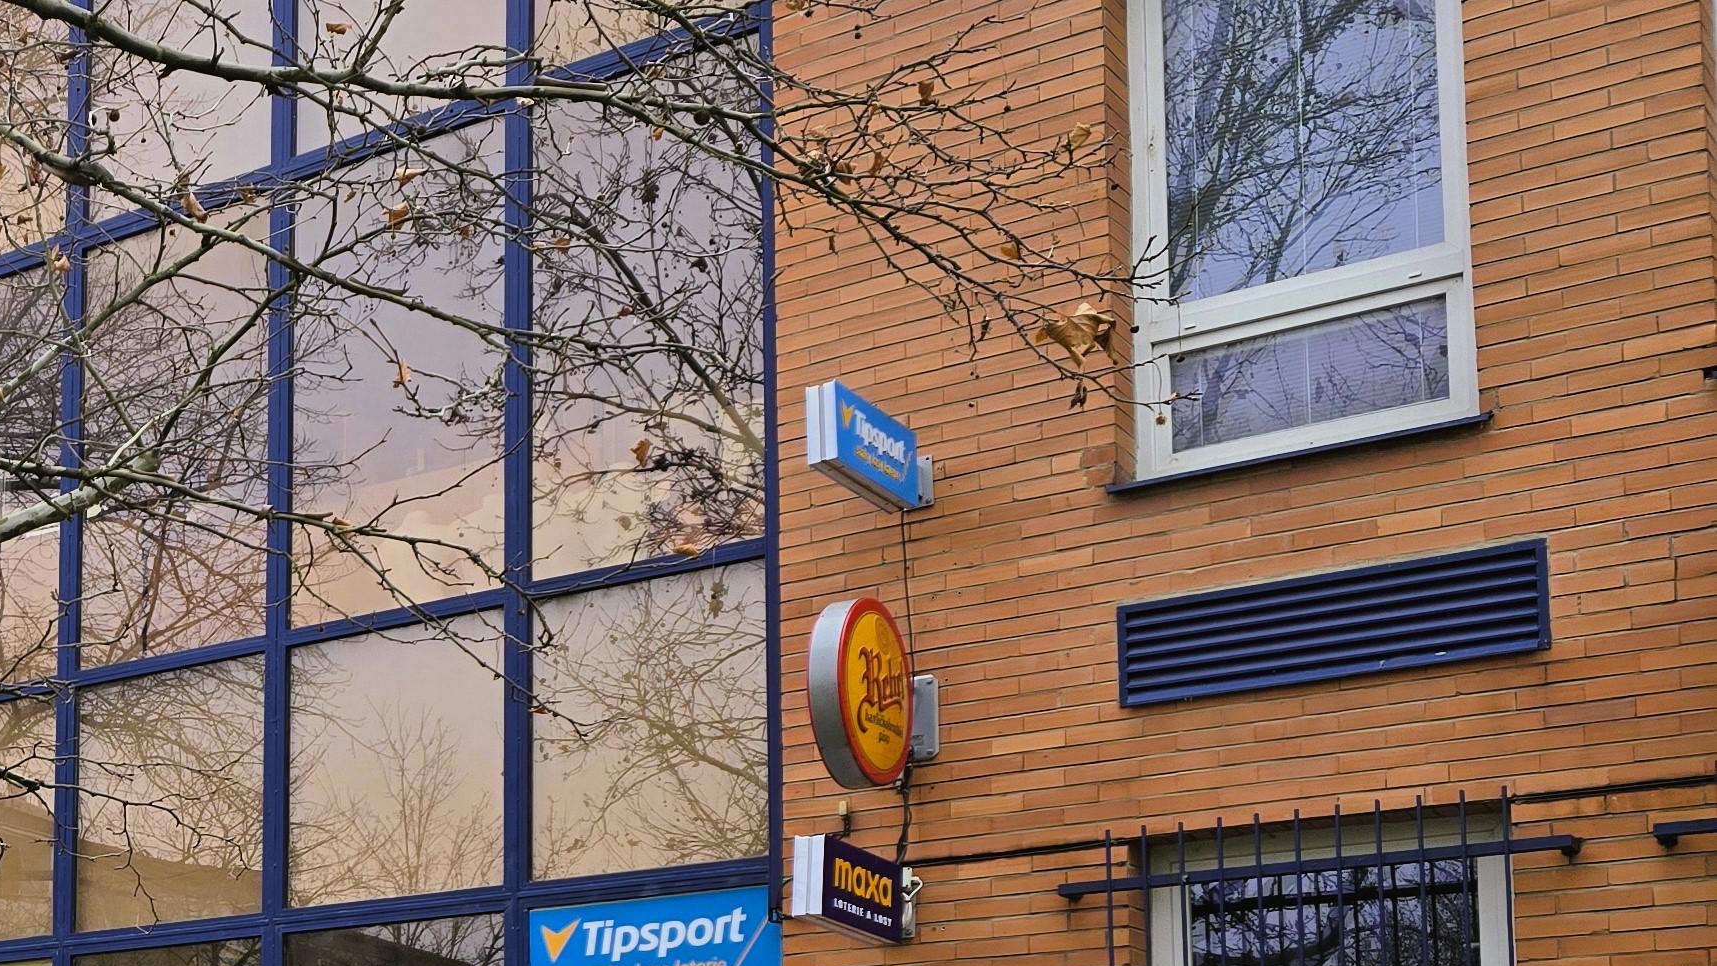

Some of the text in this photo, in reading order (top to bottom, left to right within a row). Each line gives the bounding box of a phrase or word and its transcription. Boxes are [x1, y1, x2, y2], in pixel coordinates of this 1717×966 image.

[854, 409, 906, 464] Tipsport
[834, 857, 892, 908] maxa
[582, 906, 747, 962] Tipsport
[834, 898, 892, 926] LOTERIE A LOSY
